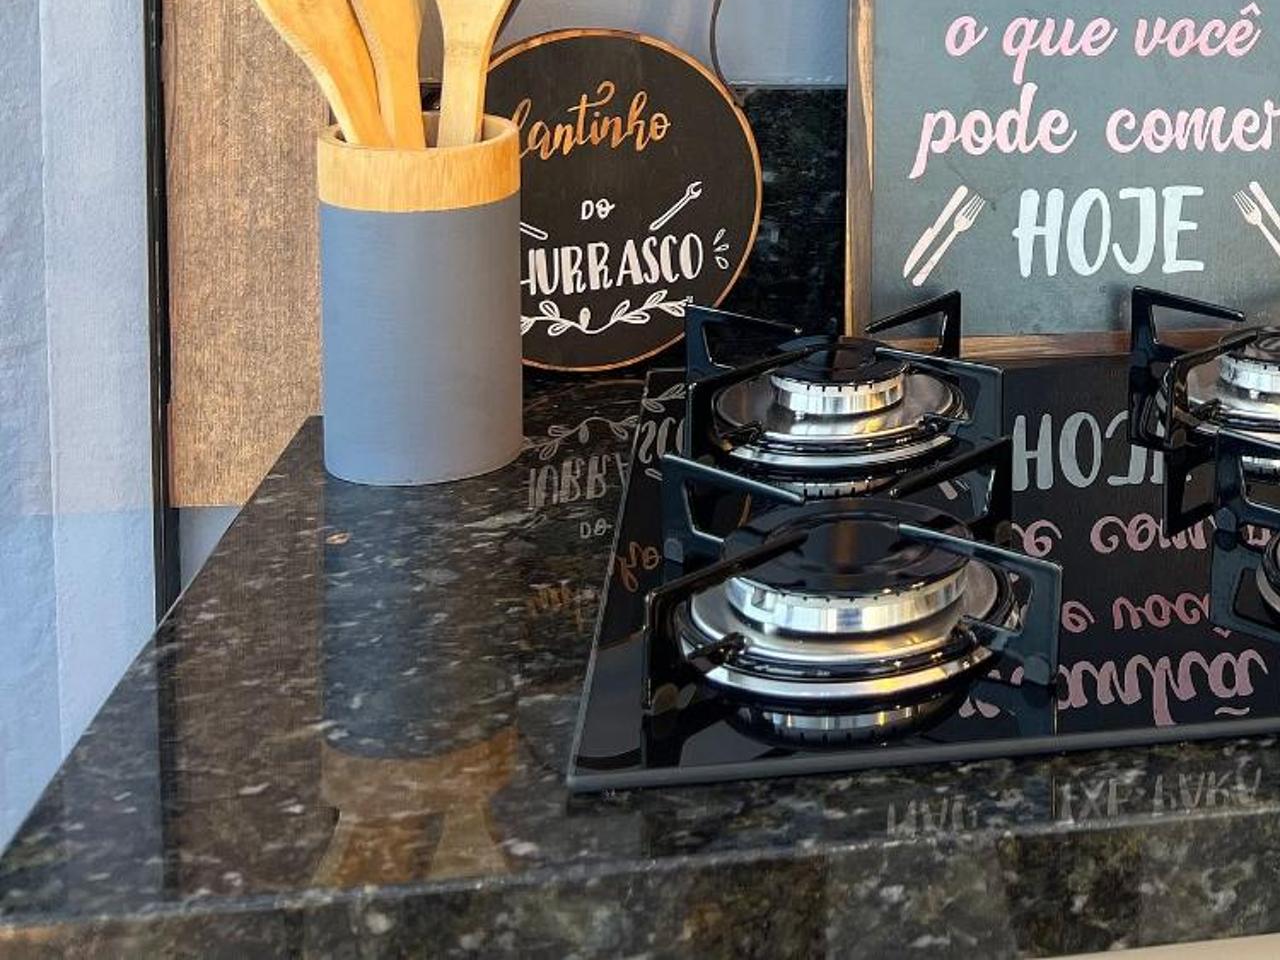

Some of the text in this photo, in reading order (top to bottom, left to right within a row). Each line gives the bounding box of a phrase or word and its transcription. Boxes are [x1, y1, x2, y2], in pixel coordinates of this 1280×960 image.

[945, 2, 1262, 85] o que você
[908, 82, 1078, 179] pode
[580, 198, 616, 221] DO
[1012, 186, 1205, 278] HOJE
[520, 232, 704, 296] HURRASCO
